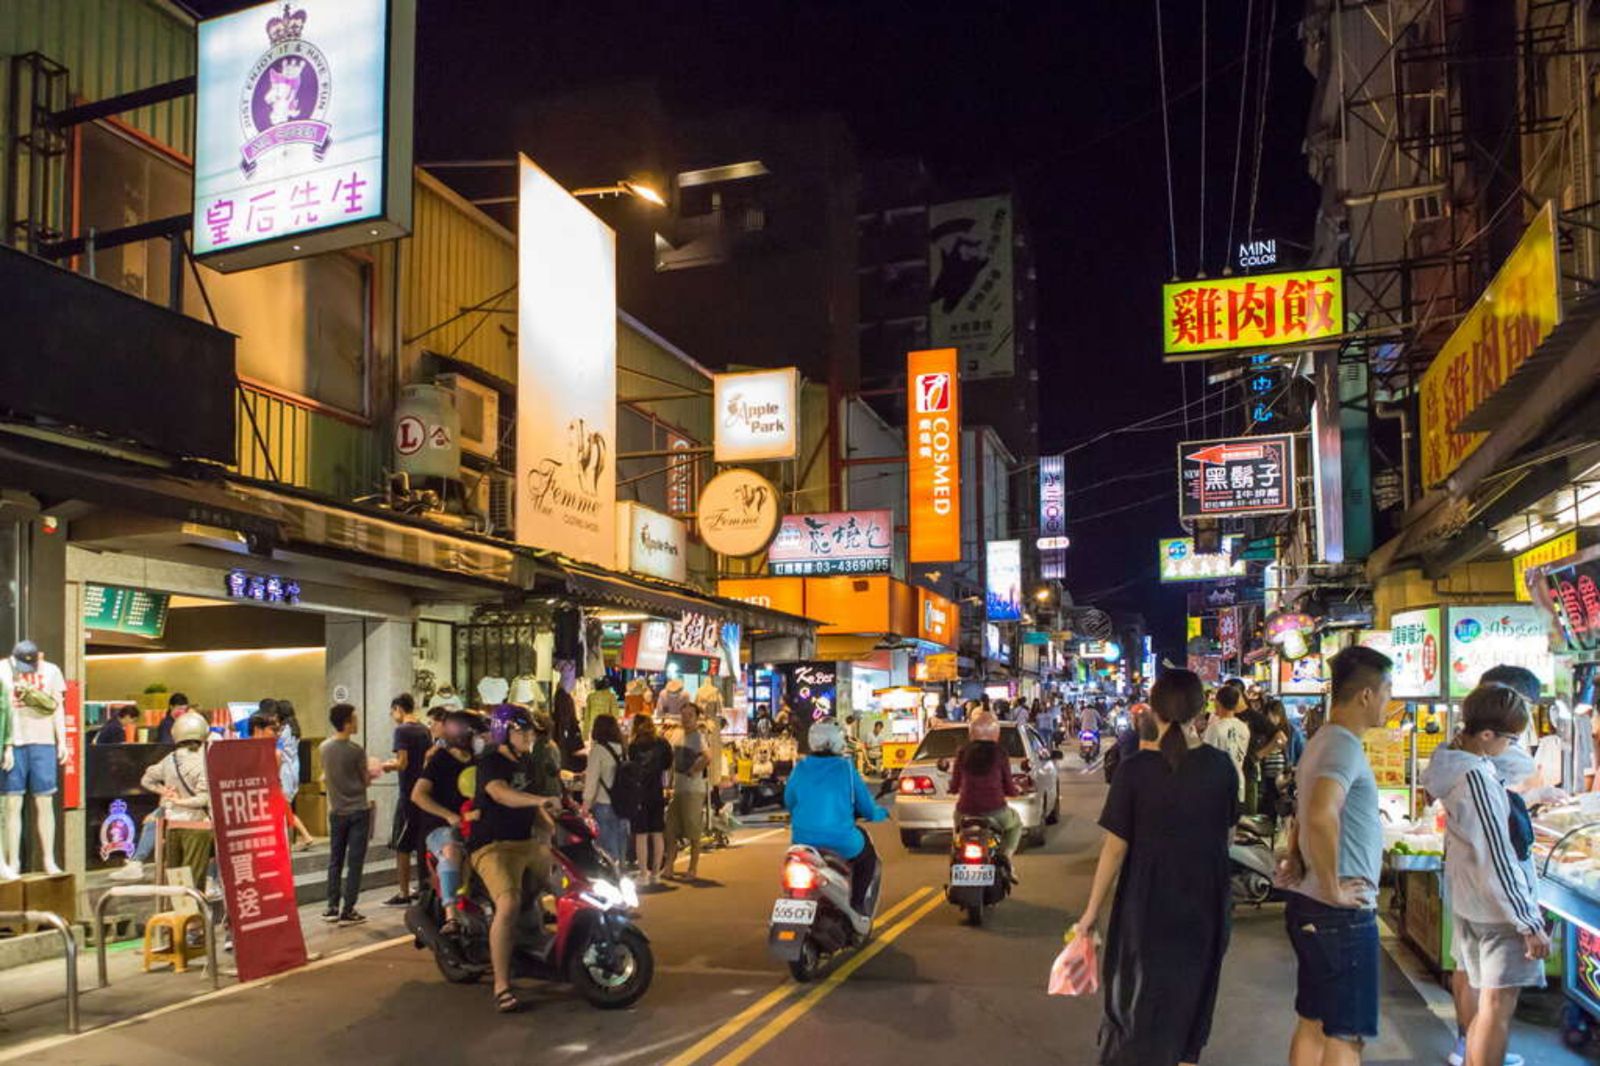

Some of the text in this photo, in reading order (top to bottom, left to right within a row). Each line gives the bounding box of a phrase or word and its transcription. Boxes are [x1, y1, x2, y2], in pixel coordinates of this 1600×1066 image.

[247, 53, 273, 90] ENJOY
[279, 44, 288, 54] IT
[307, 49, 326, 74] HAVE
[317, 82, 328, 110] FUN
[207, 171, 367, 246] 皇后先生
[1239, 239, 1276, 257] MINI
[1240, 254, 1276, 267] COLOR
[1170, 276, 1337, 345] 雞肉飯
[729, 402, 779, 427] Apple
[751, 419, 785, 433] Park
[400, 424, 417, 448] L
[932, 417, 950, 516] COSMED
[1205, 464, 1280, 490] 黑鬍子
[527, 458, 601, 514] Femme
[705, 508, 759, 531] Femme
[219, 780, 236, 789] BUY
[244, 778, 260, 787] GET
[221, 788, 273, 826] FREE
